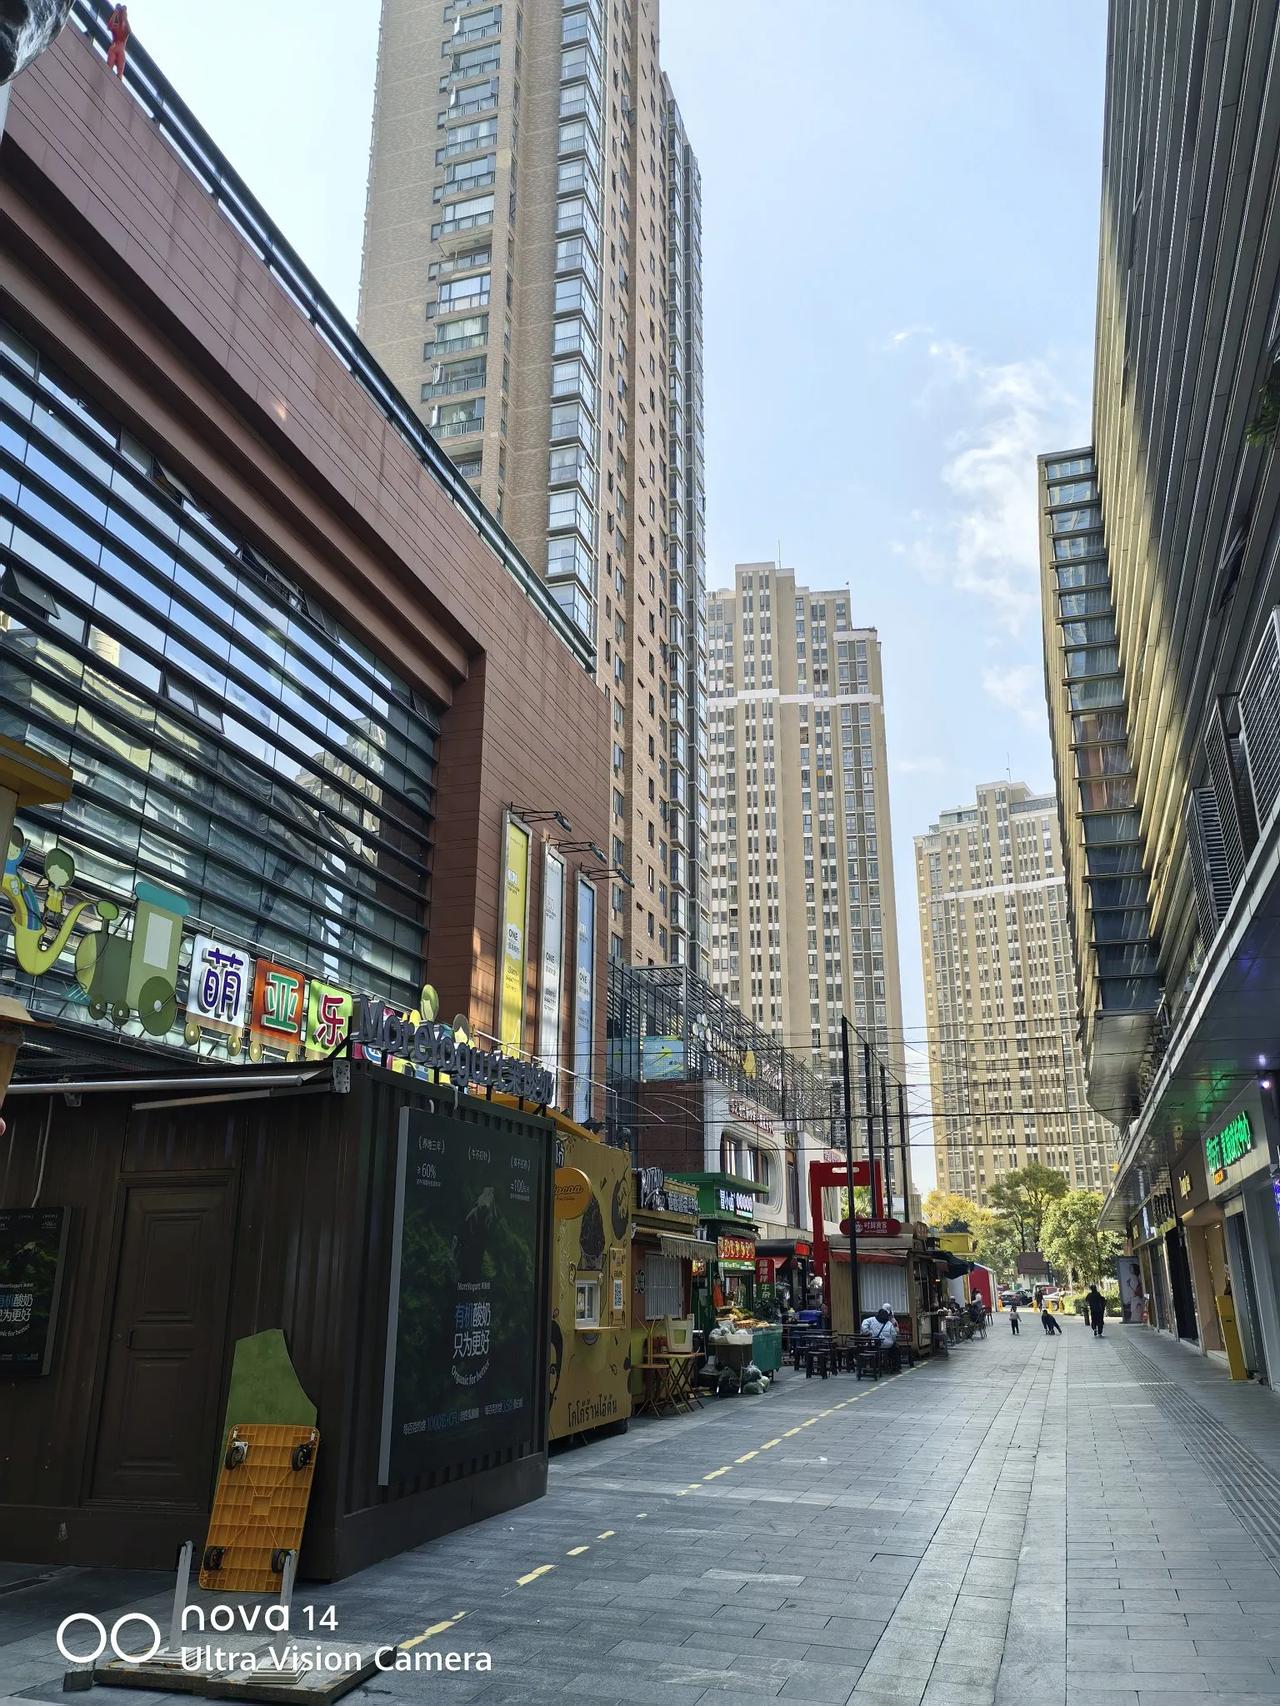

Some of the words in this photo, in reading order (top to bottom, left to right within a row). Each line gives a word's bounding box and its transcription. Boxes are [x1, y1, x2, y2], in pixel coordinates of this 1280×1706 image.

[351, 993, 507, 1092] MoreYogurt
[455, 1302, 491, 1329] 有机酸奶
[453, 1330, 490, 1359] 只为更好
[451, 1365, 469, 1386] Organic
